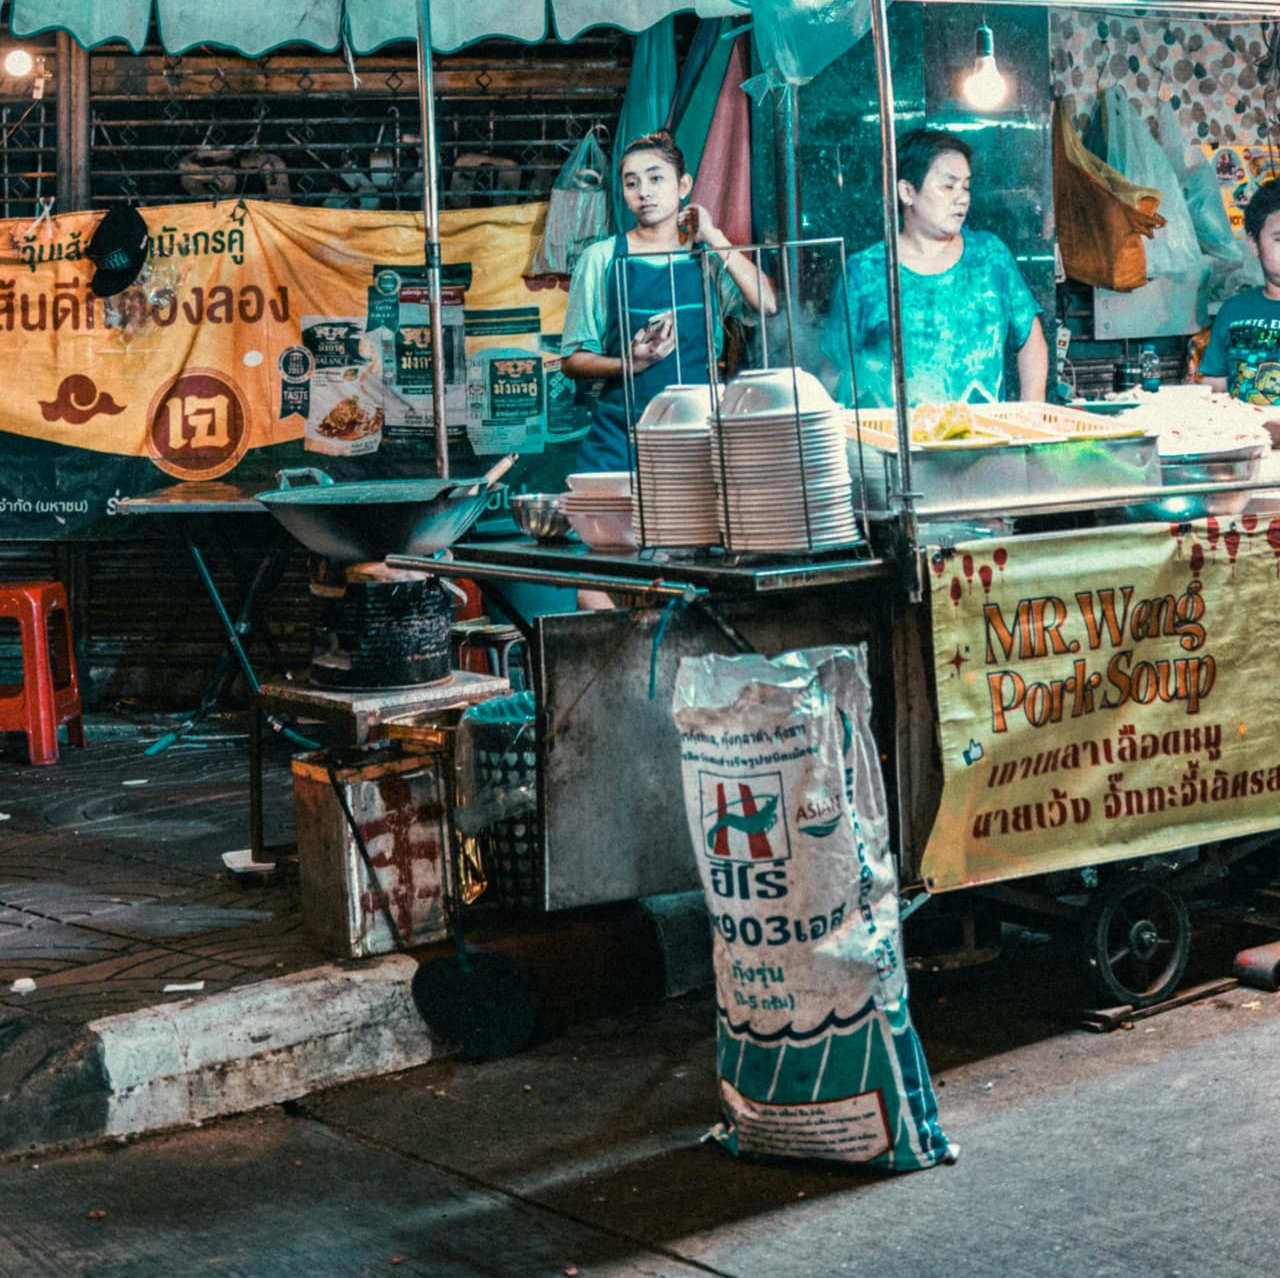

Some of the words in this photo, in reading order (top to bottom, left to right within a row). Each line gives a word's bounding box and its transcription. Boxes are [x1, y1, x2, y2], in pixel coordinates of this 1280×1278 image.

[21, 231, 86, 273] วุ้นเส้
[283, 390, 309, 401] TASTE
[987, 724, 1223, 789] เกาเหลาเลือดหมู
